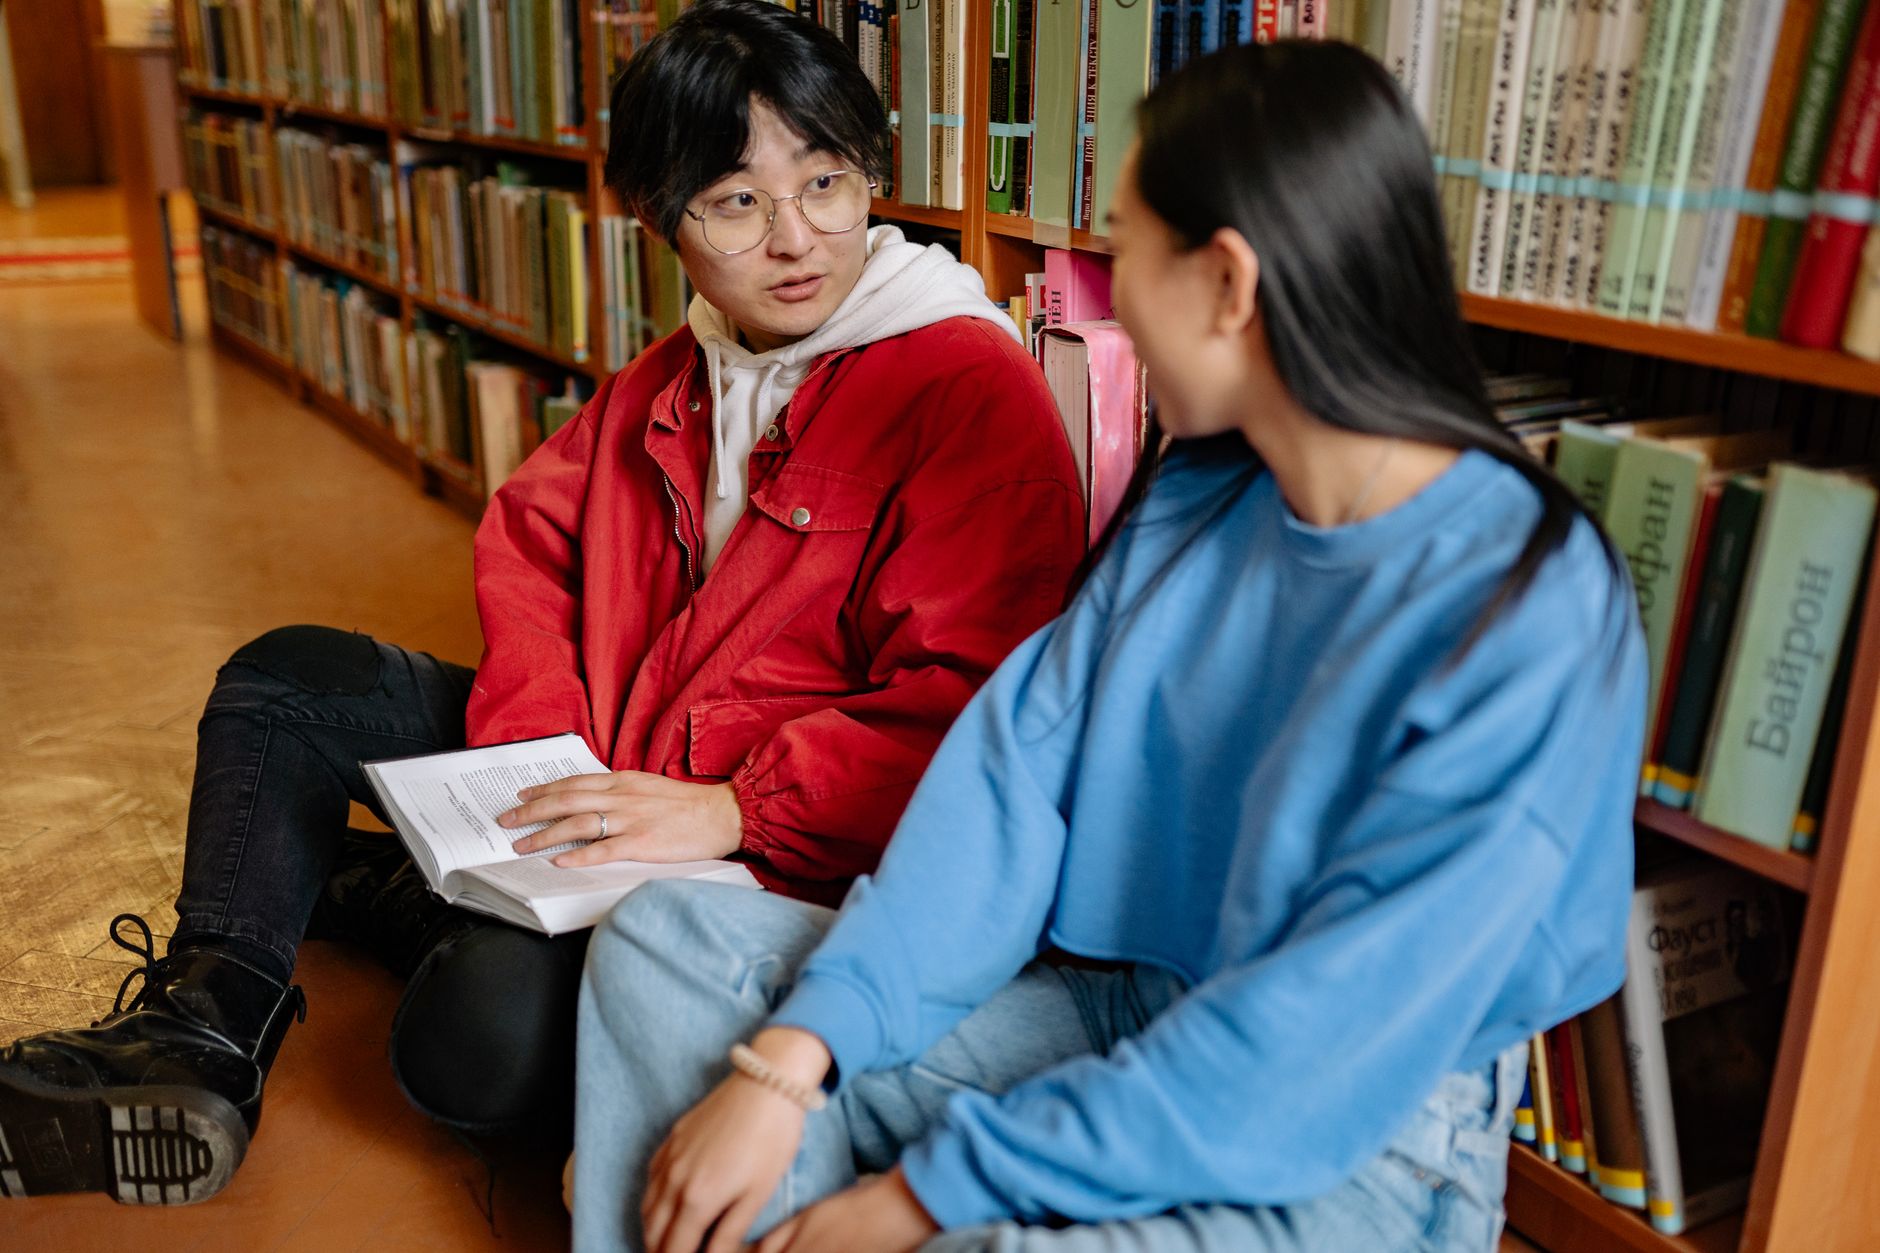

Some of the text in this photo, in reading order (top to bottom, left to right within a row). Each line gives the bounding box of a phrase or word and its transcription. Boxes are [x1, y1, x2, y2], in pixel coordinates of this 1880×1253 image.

[1088, 38, 1097, 79] ТЕКСТУ
[1083, 175, 1092, 221] Вера Резник
[1628, 476, 1675, 612] офан
[1746, 559, 1835, 759] Байрон
[1648, 918, 1718, 956] Фауст
